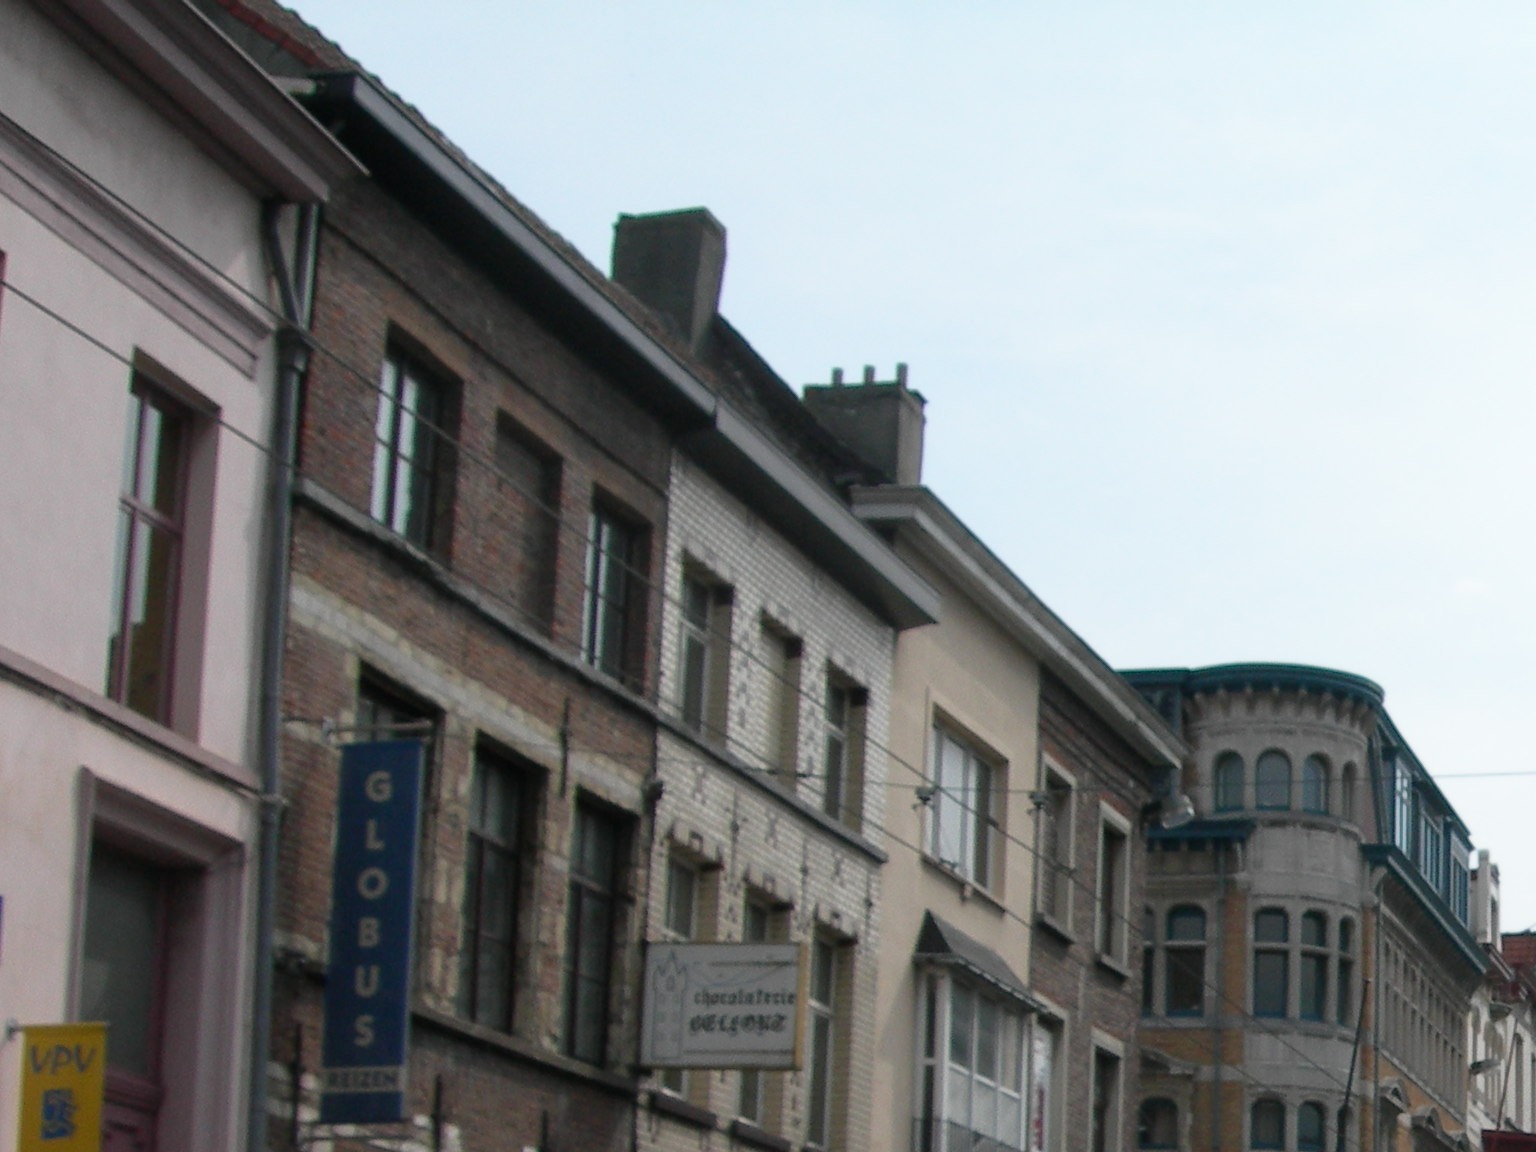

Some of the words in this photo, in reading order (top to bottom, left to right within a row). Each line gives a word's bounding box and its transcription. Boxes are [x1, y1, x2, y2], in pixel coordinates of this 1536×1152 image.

[354, 769, 394, 1048] GLOBUS
[30, 1044, 98, 1075] VPV
[328, 1070, 397, 1090] REIZEN
